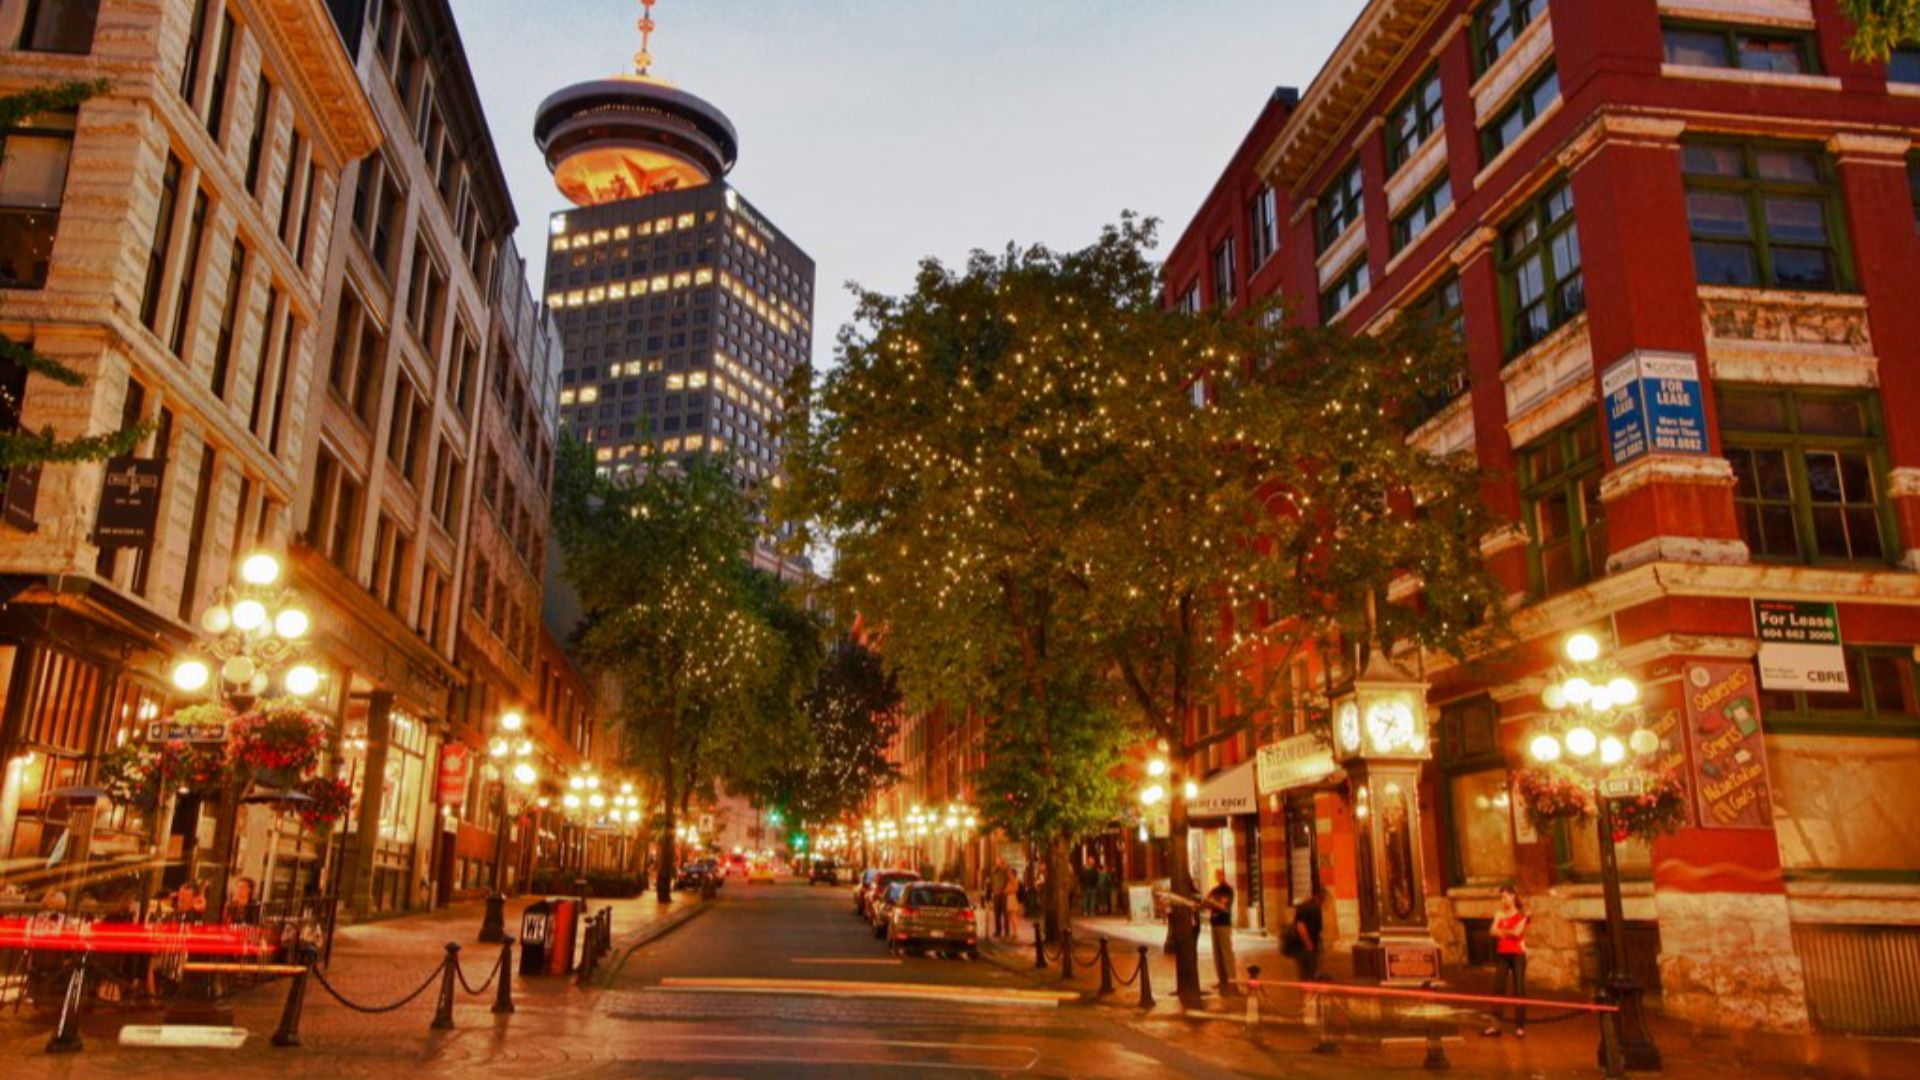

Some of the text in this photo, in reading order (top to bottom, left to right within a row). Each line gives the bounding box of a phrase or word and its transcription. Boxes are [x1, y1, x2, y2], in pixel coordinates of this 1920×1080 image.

[1660, 380, 1684, 392] FOR
[1656, 391, 1691, 406] LEASE
[1612, 396, 1635, 419] LEASE
[1760, 611, 1834, 628] For Lease
[1761, 628, 1783, 639] 604
[1806, 669, 1846, 683] CBRE
